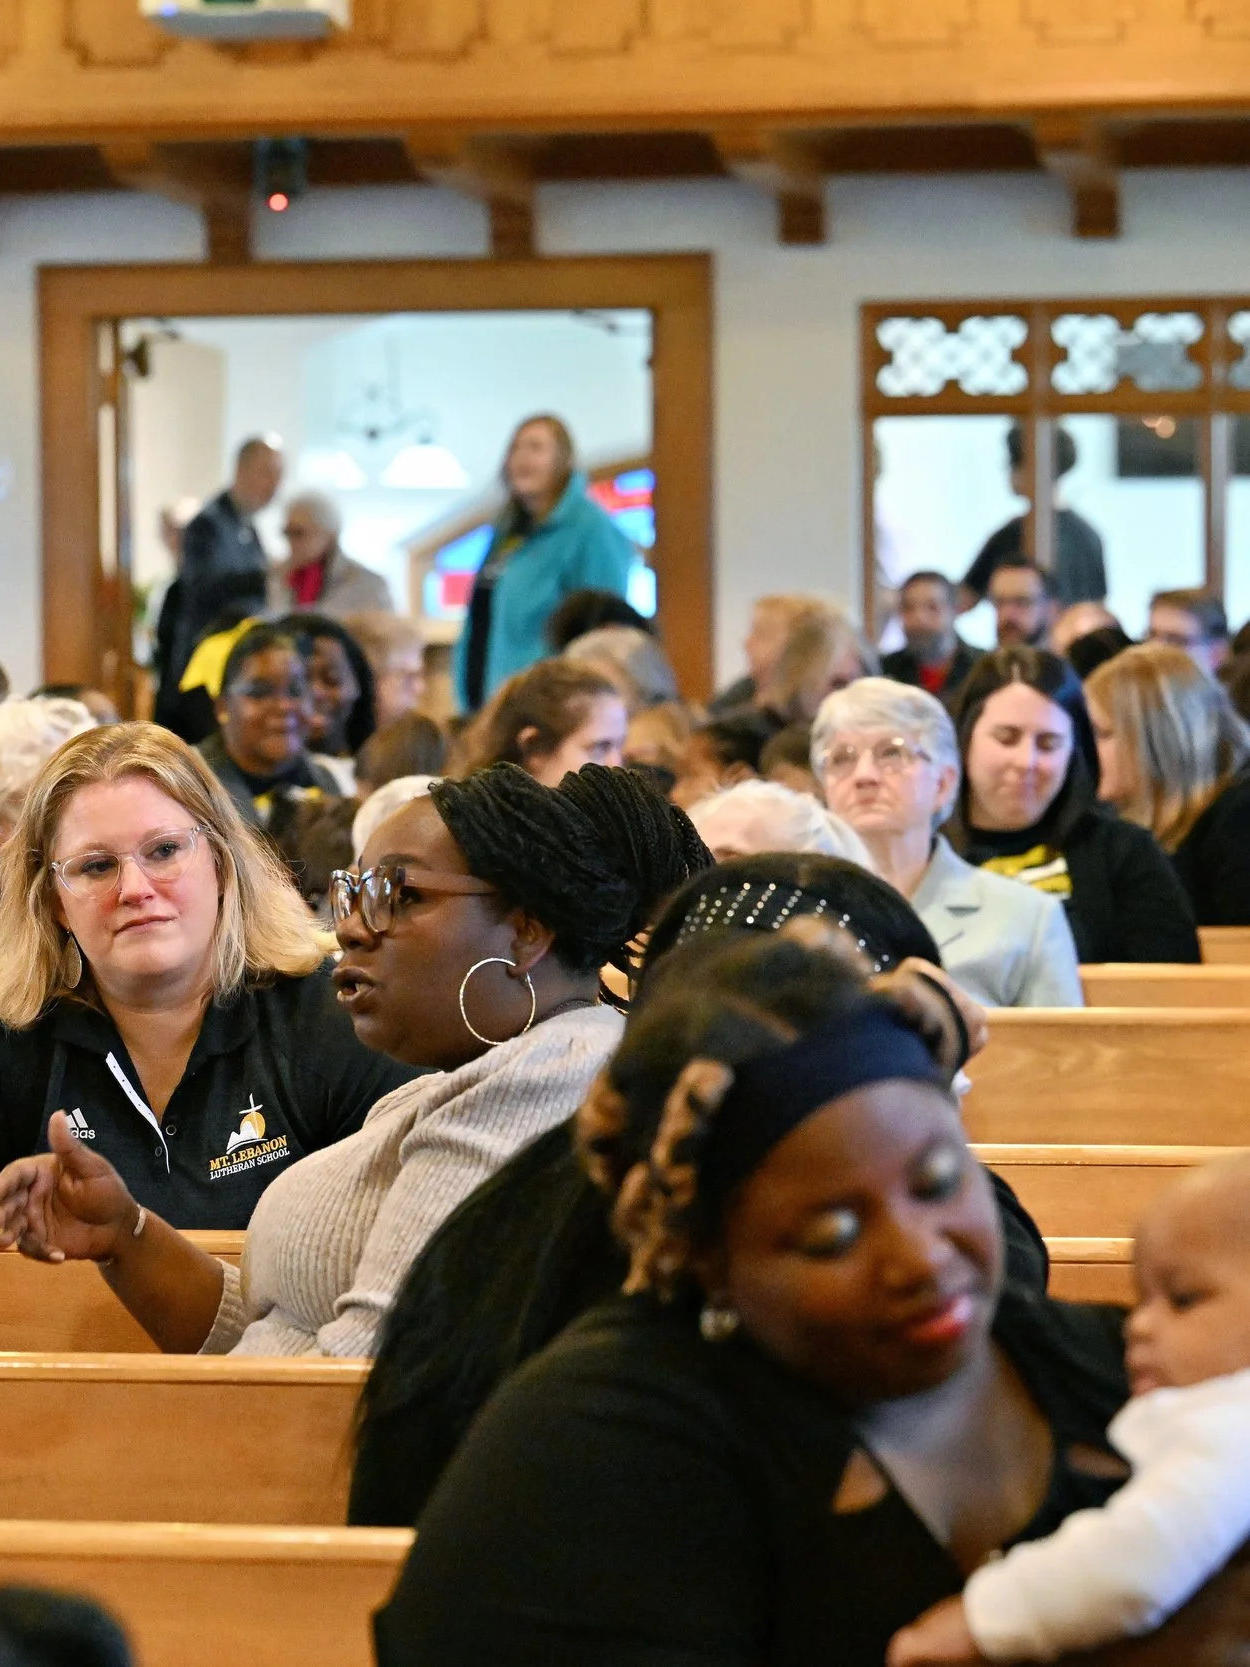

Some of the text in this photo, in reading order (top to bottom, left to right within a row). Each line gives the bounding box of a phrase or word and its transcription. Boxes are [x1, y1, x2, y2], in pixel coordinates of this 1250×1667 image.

[70, 1127, 96, 1139] das
[209, 1134, 288, 1171] MT. LEBANON
[210, 1147, 290, 1180] LUTHERAN SCHOOL
